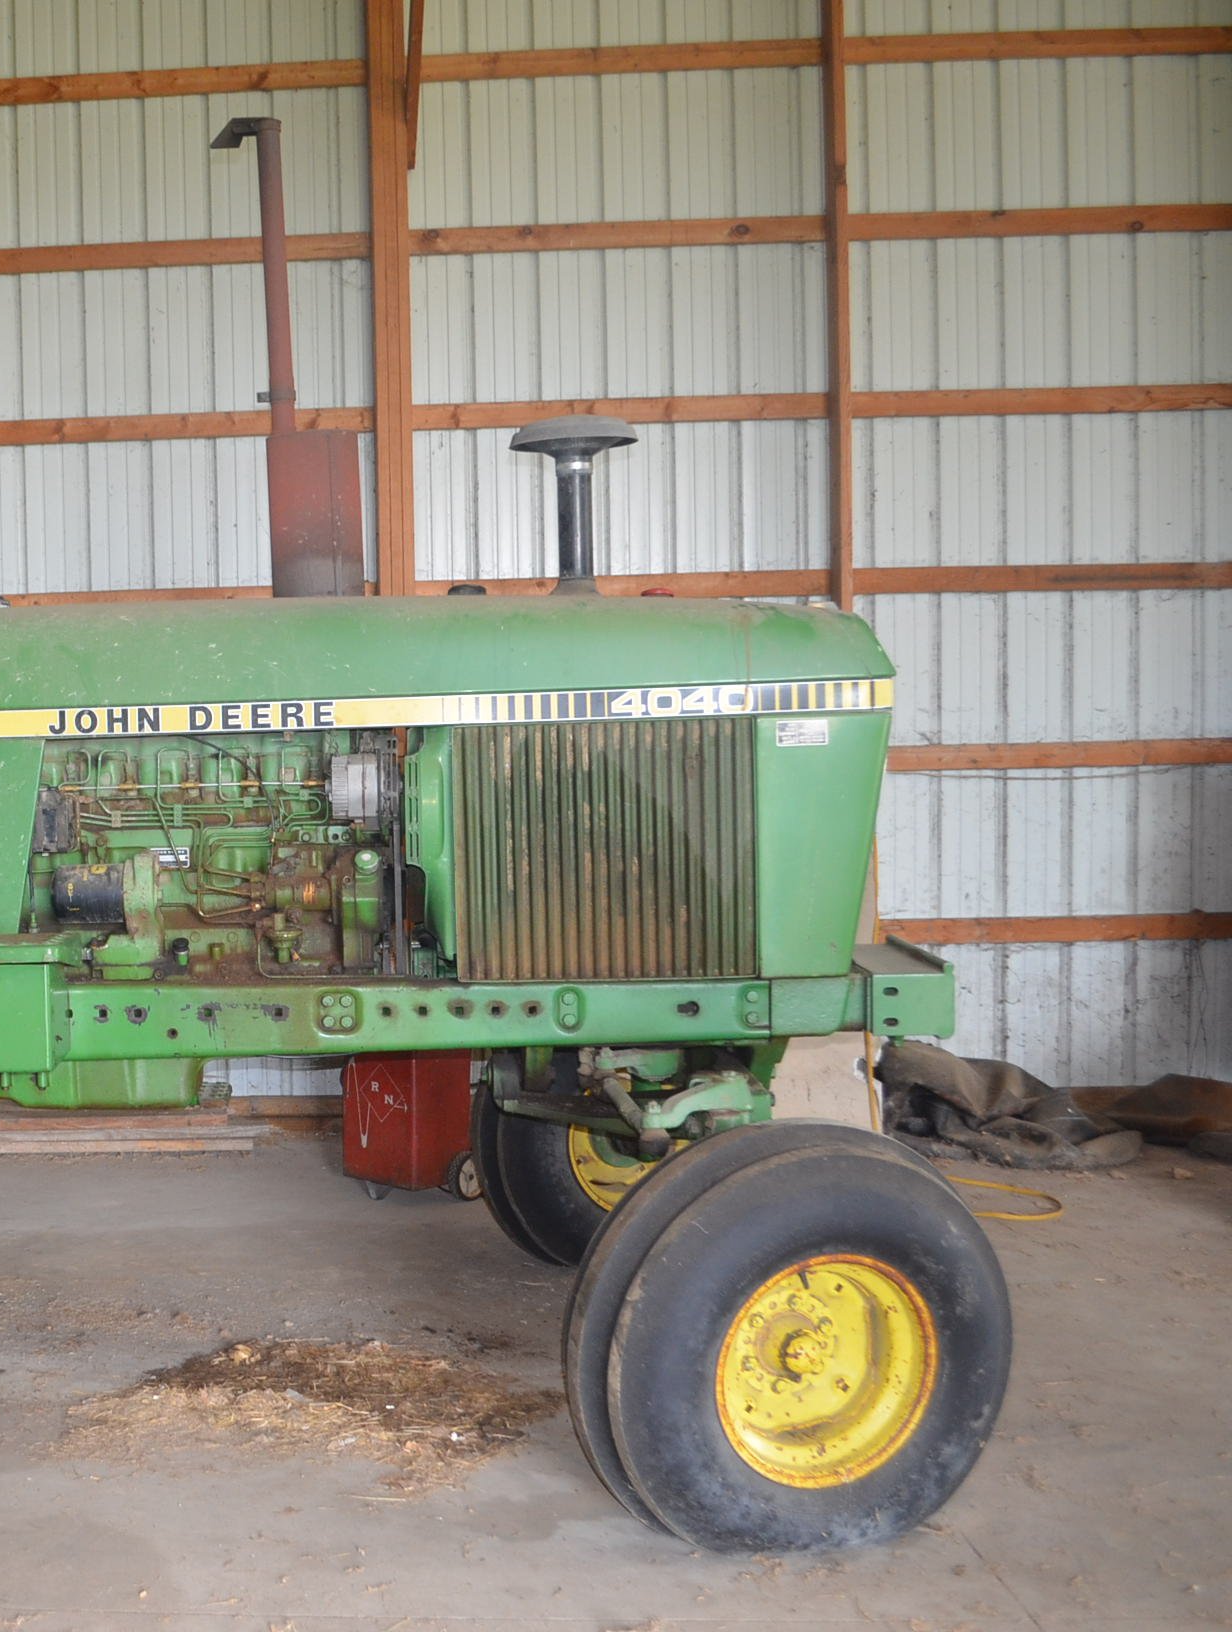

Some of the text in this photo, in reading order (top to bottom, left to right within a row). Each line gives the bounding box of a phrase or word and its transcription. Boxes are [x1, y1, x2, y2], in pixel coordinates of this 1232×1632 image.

[610, 686, 754, 717] 4040
[48, 700, 335, 735] JOHN DEERE
[370, 1080, 380, 1093] R
[384, 1093, 394, 1106] N
